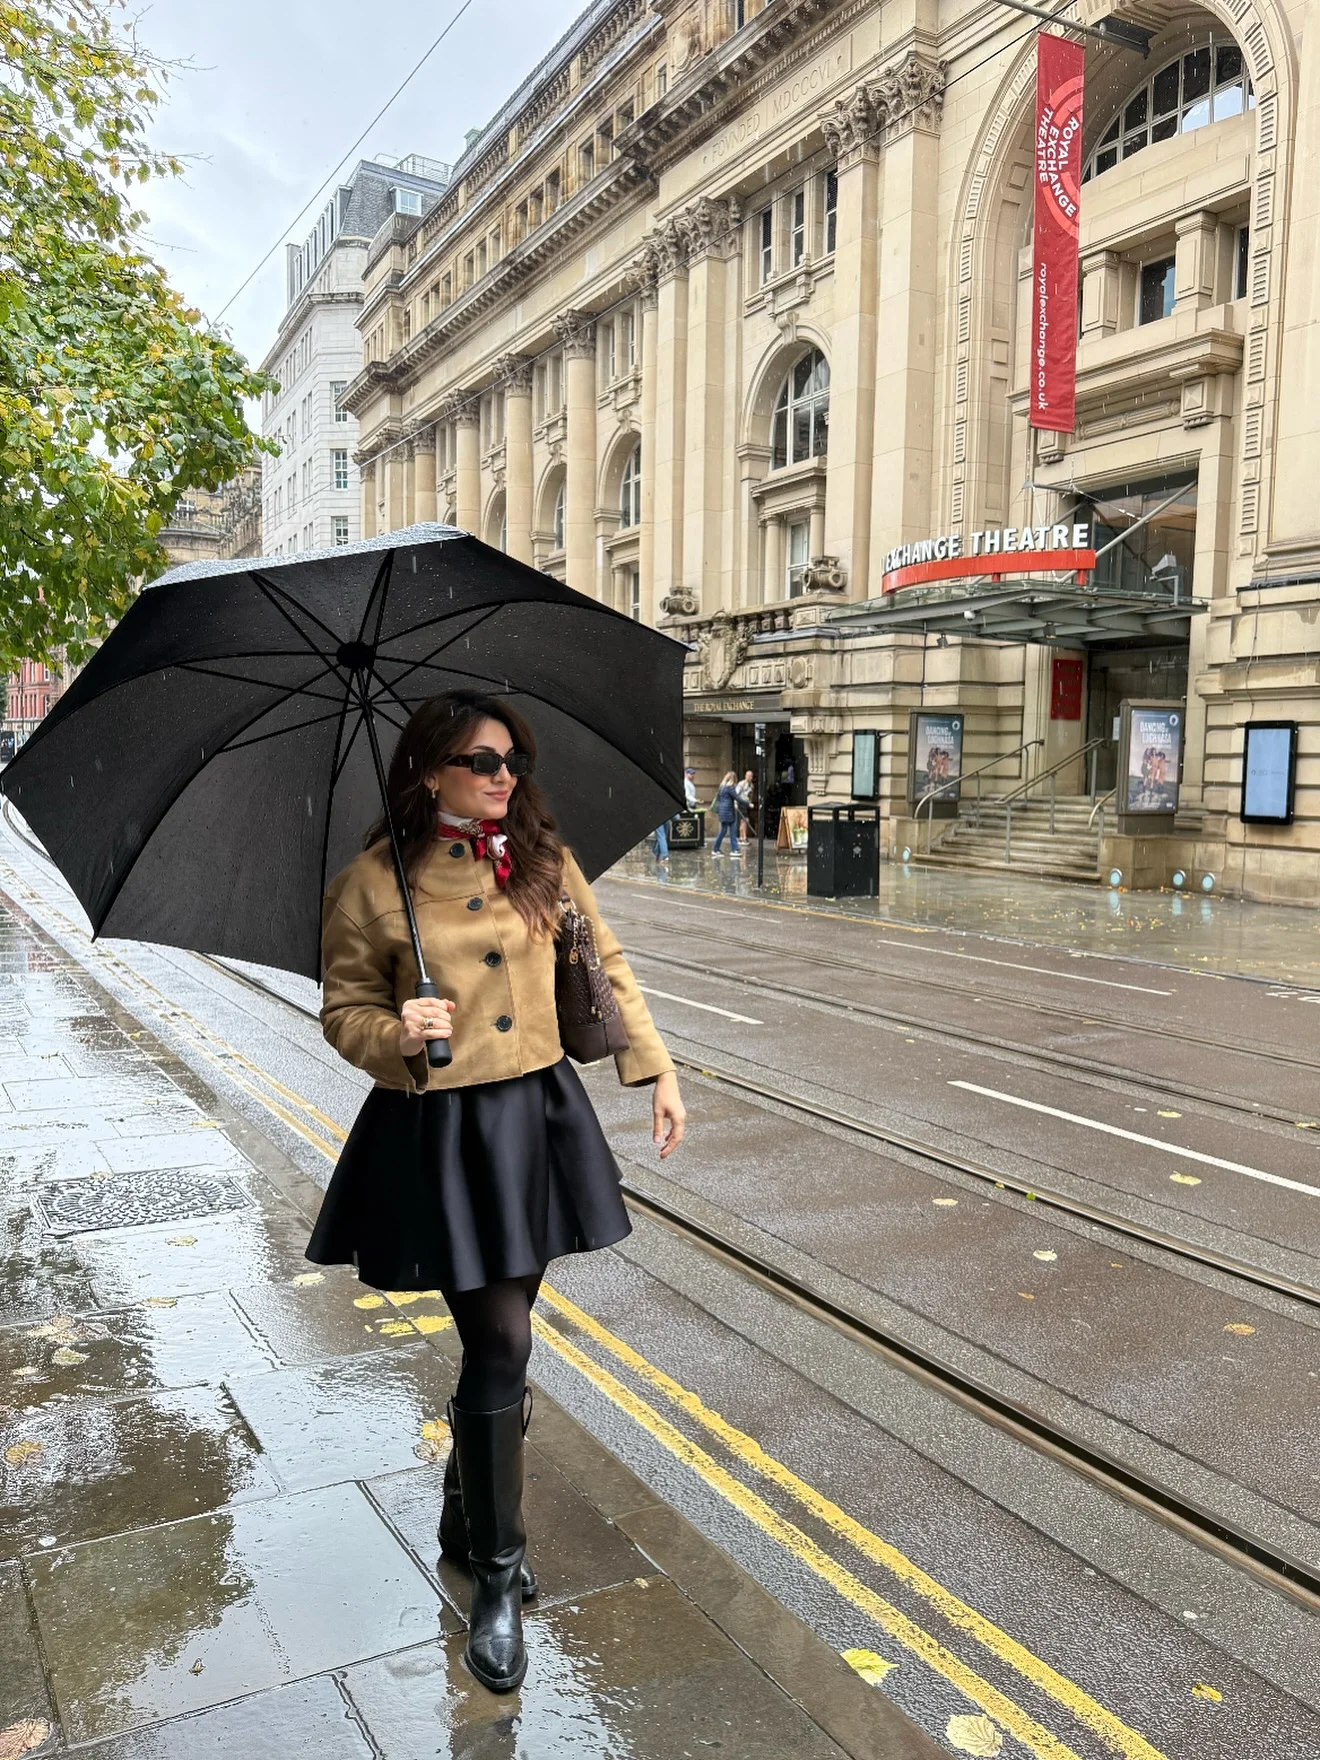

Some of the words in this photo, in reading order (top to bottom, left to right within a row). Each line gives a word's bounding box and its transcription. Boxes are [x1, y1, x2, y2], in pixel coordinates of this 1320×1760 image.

[772, 58, 831, 118] MDCCCVI
[1037, 107, 1053, 183] THEATRE
[1047, 125, 1077, 217] EXCHANGE
[1058, 116, 1080, 170] ROYAL
[1037, 262, 1048, 410] royalexchange.co.uk
[886, 536, 962, 572] EXCHANGE
[970, 523, 1088, 553] THEATRE
[723, 701, 754, 711] EXCHANGE
